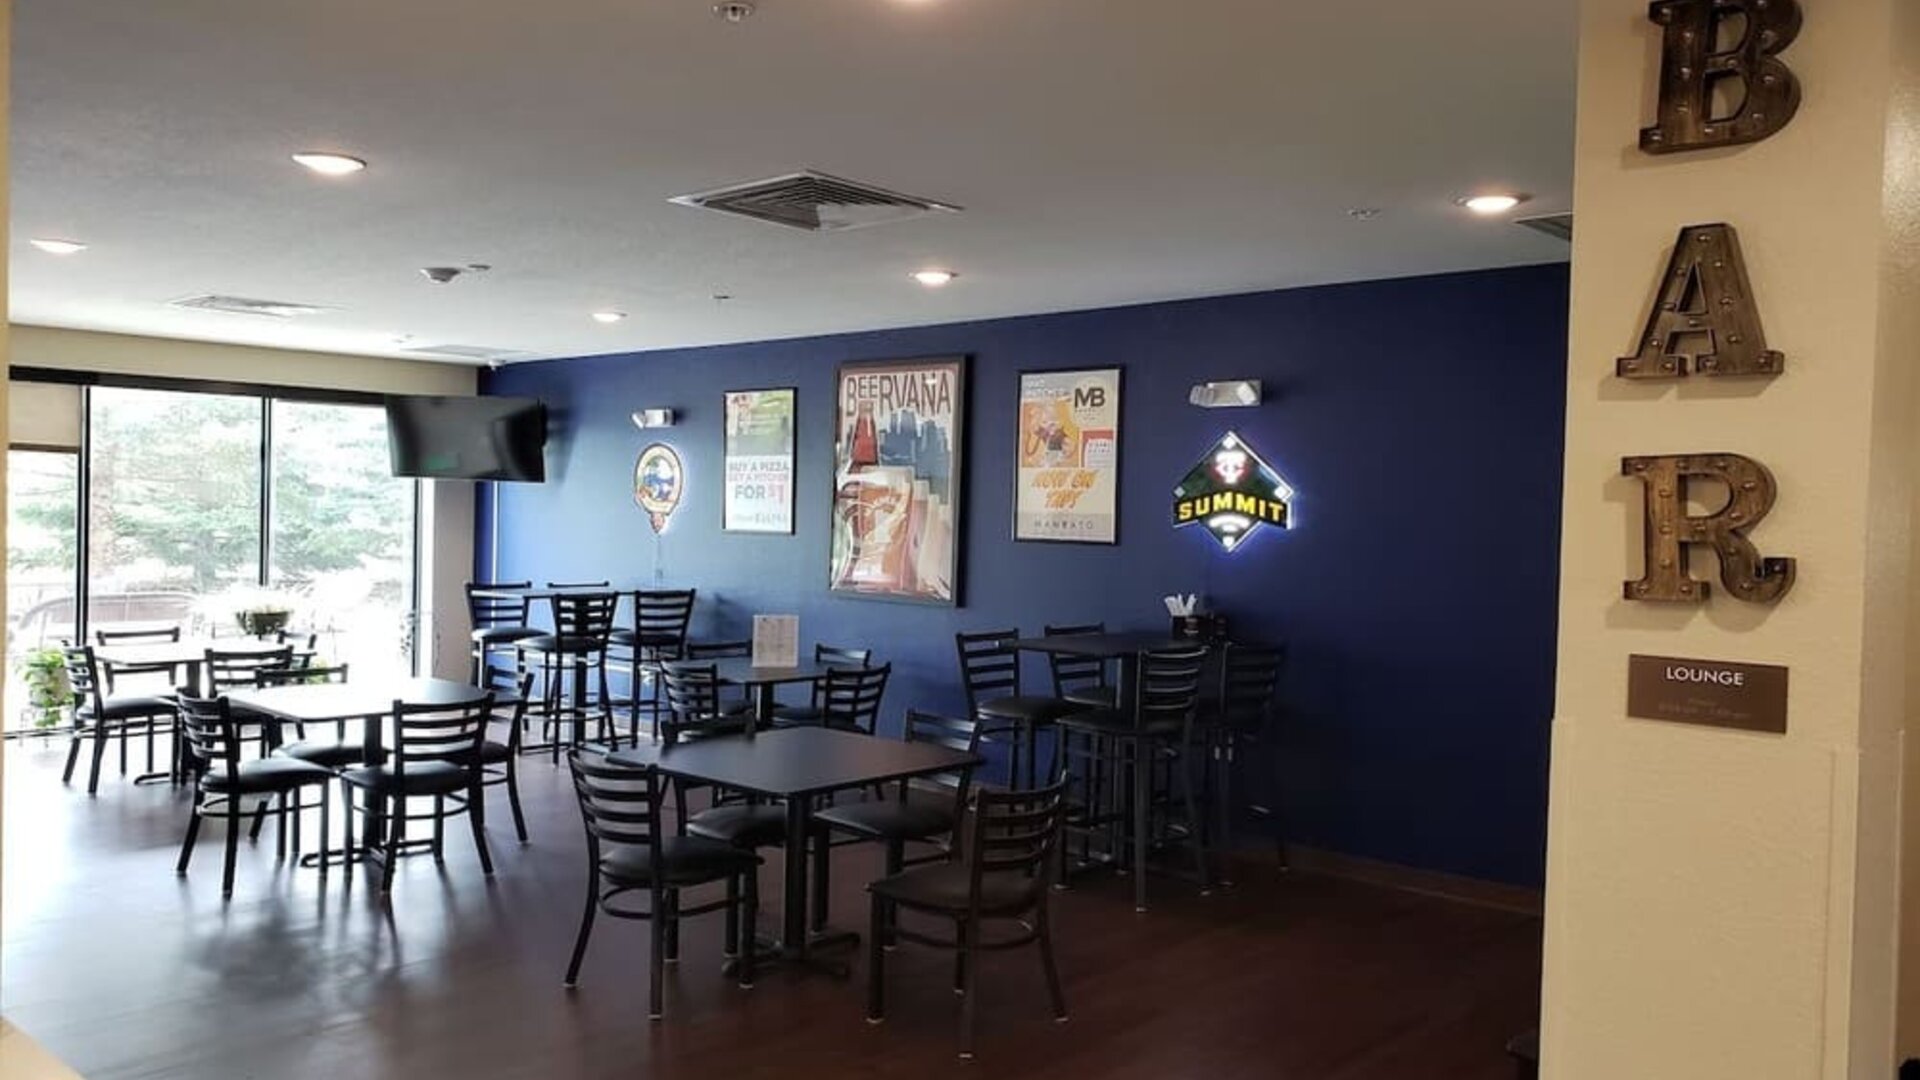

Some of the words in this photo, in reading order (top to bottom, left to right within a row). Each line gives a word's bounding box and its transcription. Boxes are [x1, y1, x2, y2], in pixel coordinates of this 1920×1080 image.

[845, 372, 952, 418] BEERVANA
[1074, 387, 1105, 408] MB
[760, 461, 789, 472] PIZZA
[734, 484, 766, 500] FOR
[1178, 491, 1283, 521] SUMMIT
[1666, 666, 1744, 686] LOUNGE
